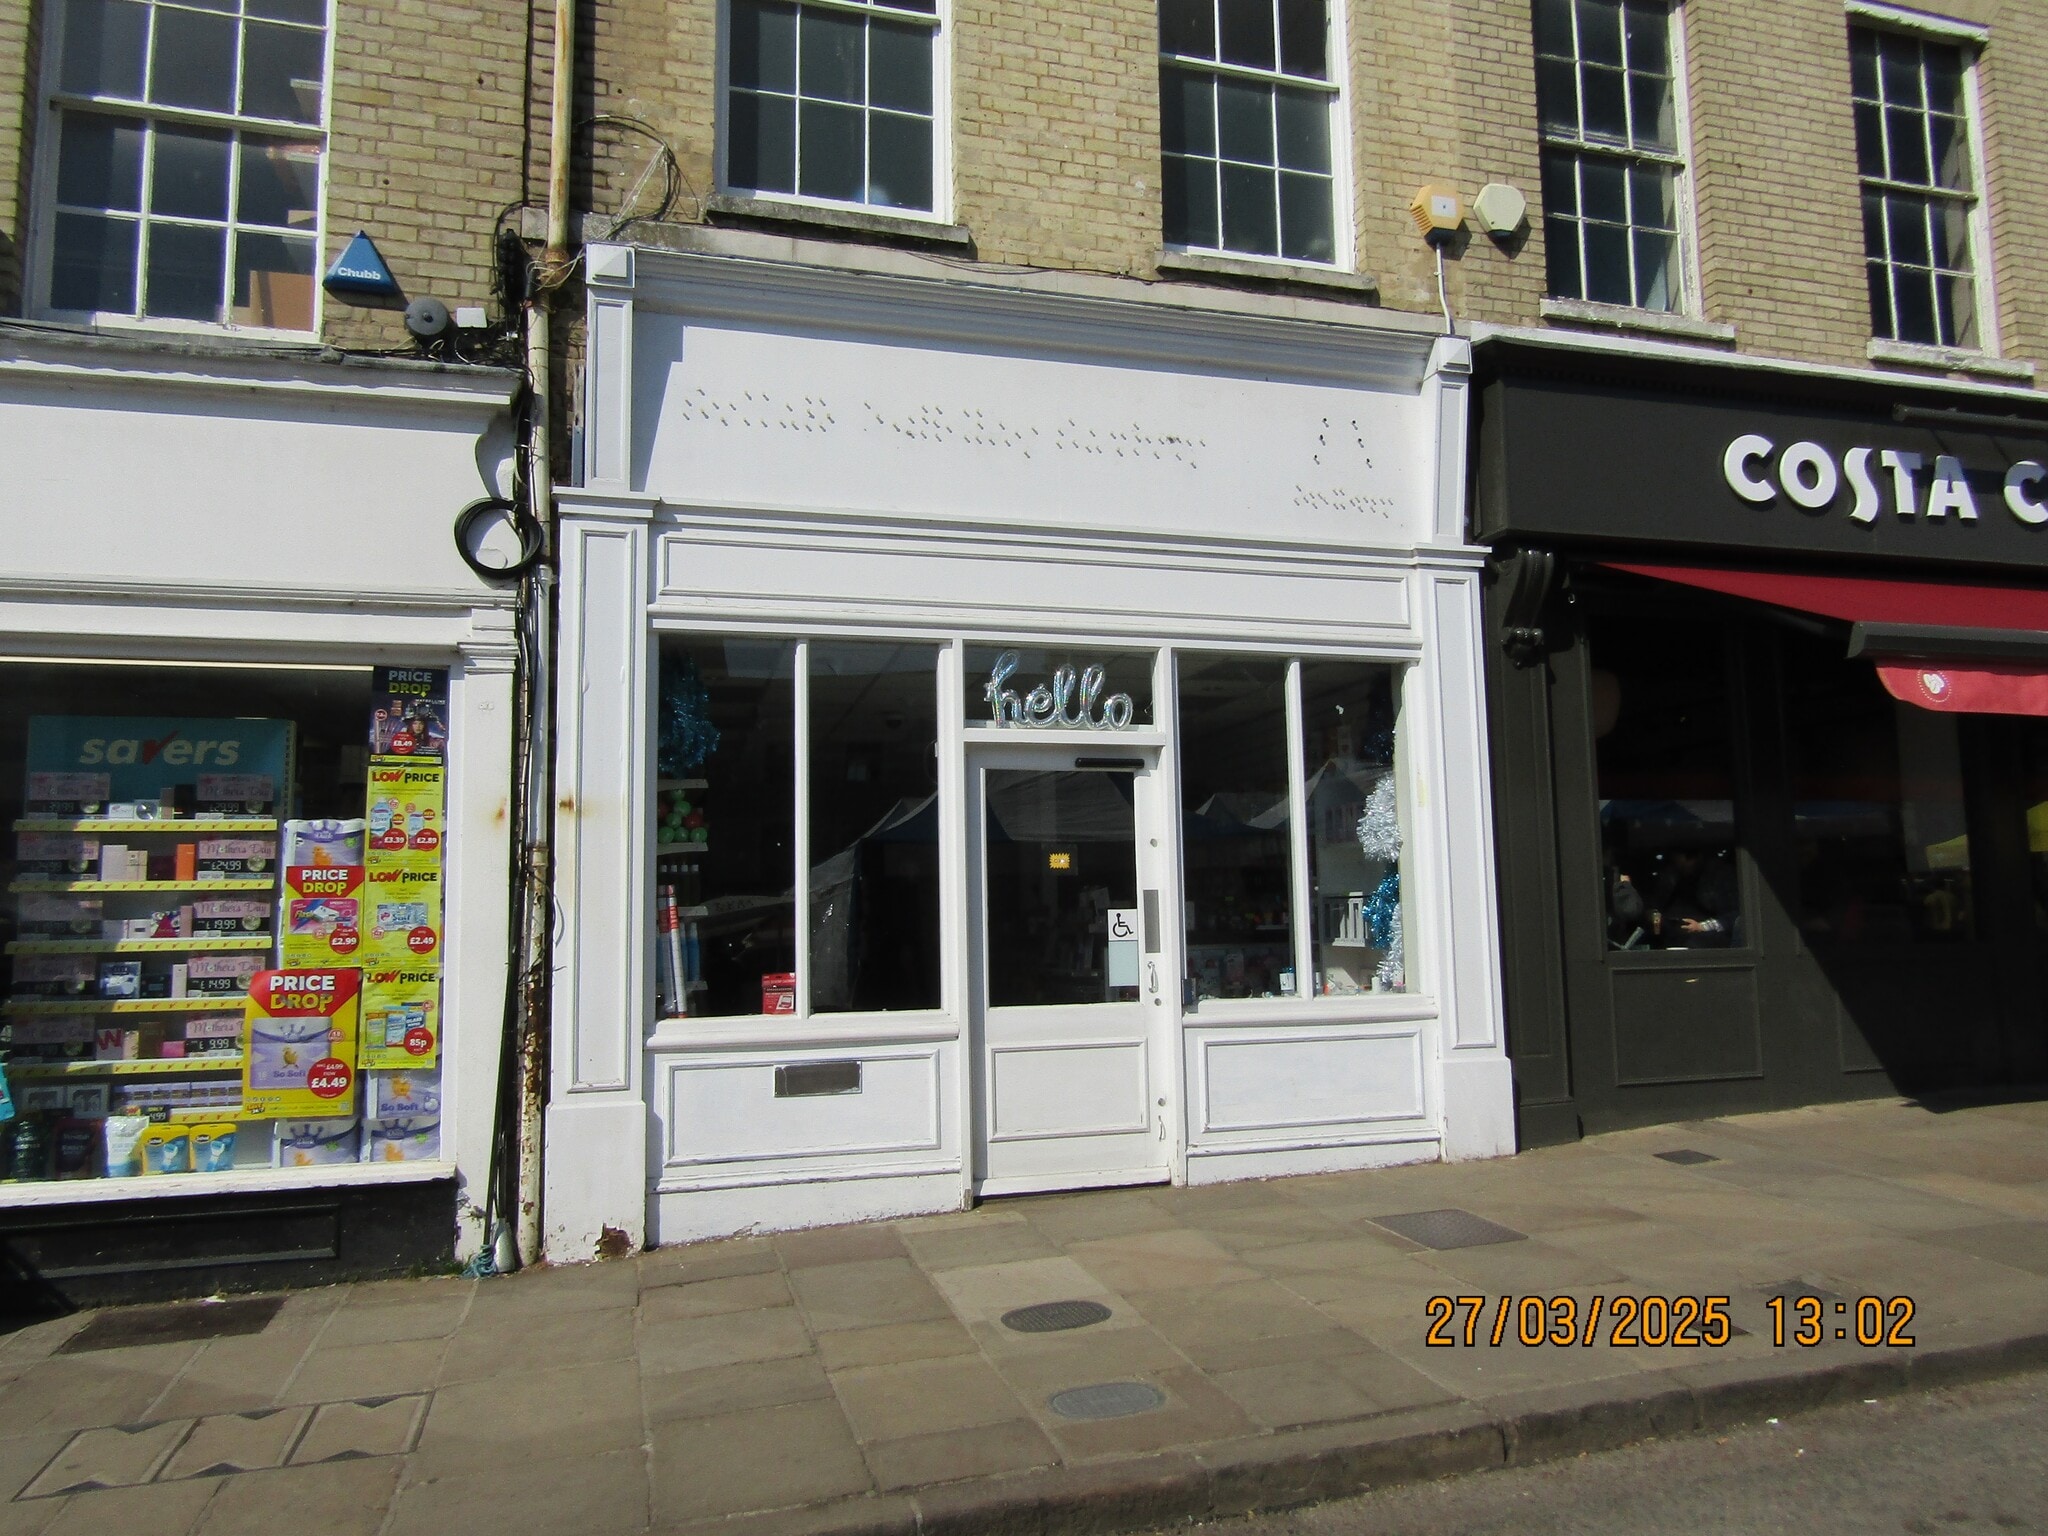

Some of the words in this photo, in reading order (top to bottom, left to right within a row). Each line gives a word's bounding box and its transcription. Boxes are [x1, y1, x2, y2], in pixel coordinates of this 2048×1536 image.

[337, 267, 381, 280] Chubb
[1723, 434, 1979, 523] COSTA
[388, 670, 432, 682] PRICE
[388, 682, 432, 697] DROP
[983, 651, 1133, 731] hello
[79, 729, 241, 765] savers
[372, 769, 406, 782] LOW
[405, 773, 440, 783] PRICE
[211, 860, 242, 870] £24.99
[302, 869, 349, 881] PRICE
[369, 869, 404, 882] LOW
[402, 872, 438, 883] PRICE
[302, 882, 348, 897] DROP
[331, 937, 357, 946] £2.99
[409, 937, 434, 945] £2.49
[269, 975, 335, 991] PRICE
[367, 970, 401, 983] LOW
[400, 973, 436, 984] PRICE
[270, 993, 334, 1014] DROP
[409, 1038, 427, 1047] 85p
[311, 1076, 347, 1088] £4.49
[380, 1102, 395, 1112] So
[397, 1102, 419, 1111] Soft
